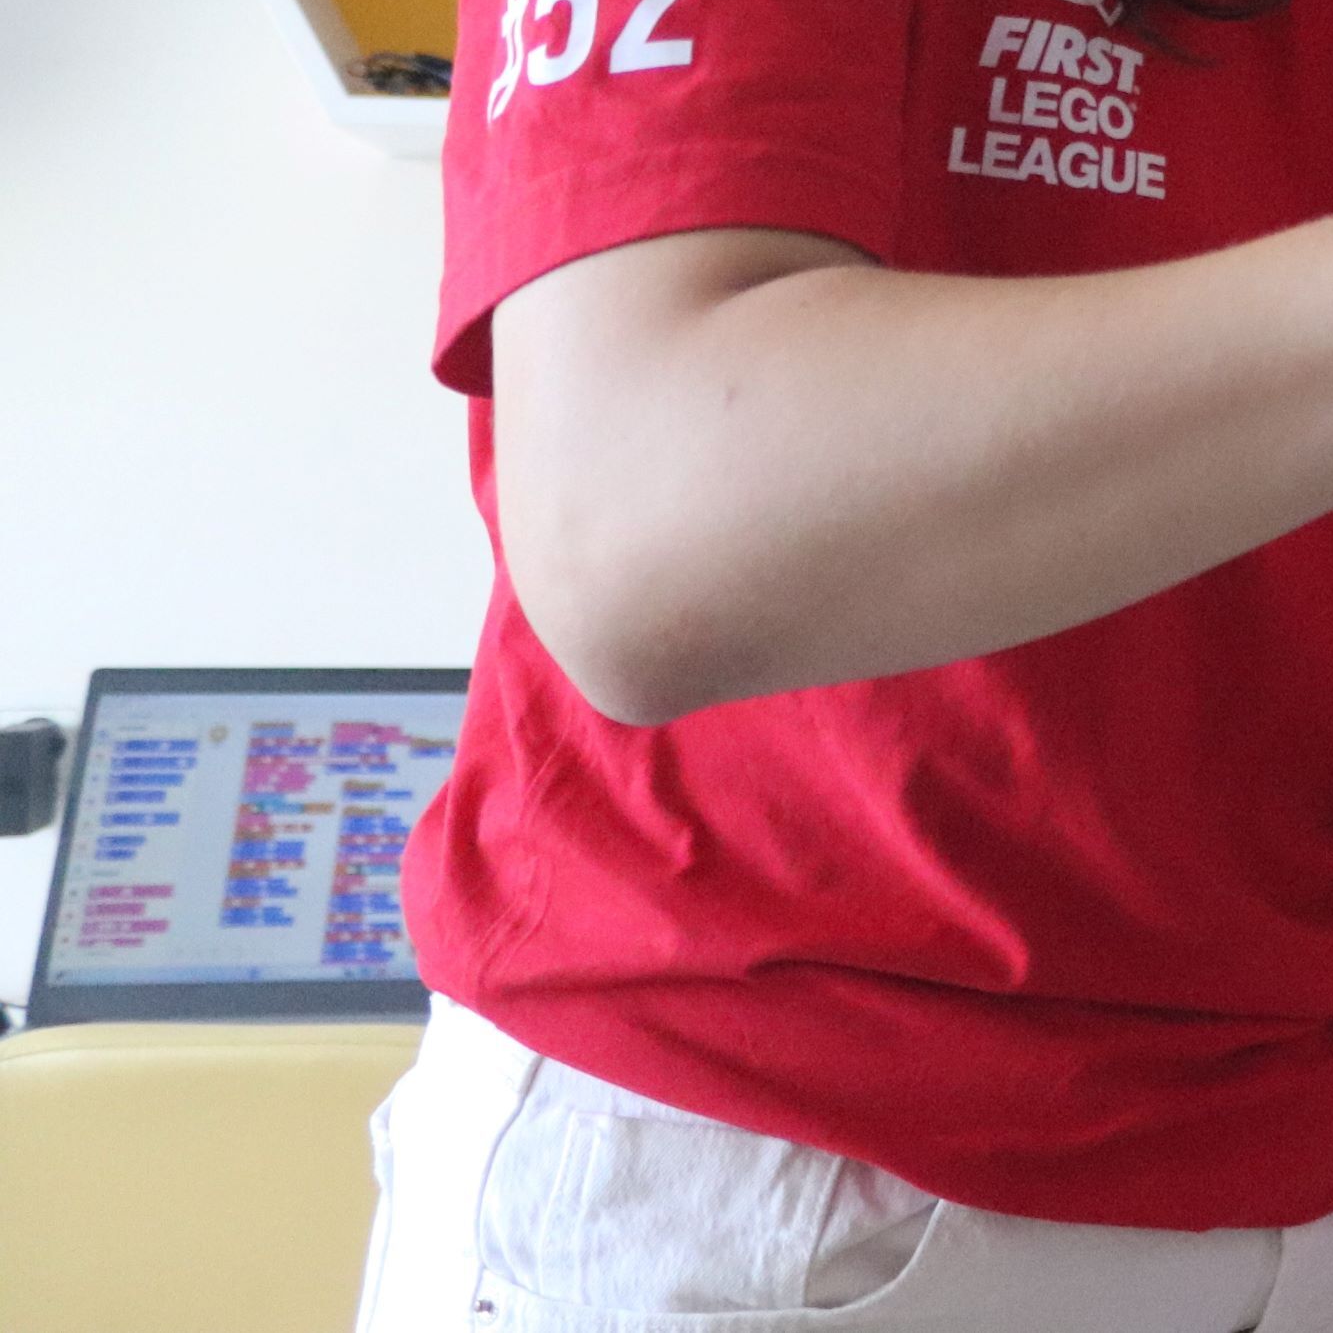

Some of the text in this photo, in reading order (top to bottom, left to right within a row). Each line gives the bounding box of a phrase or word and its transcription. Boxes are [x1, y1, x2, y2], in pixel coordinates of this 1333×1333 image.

[979, 16, 1144, 95] FIRST
[988, 76, 1135, 141] LEGO
[947, 126, 1167, 201] LEAGUE
